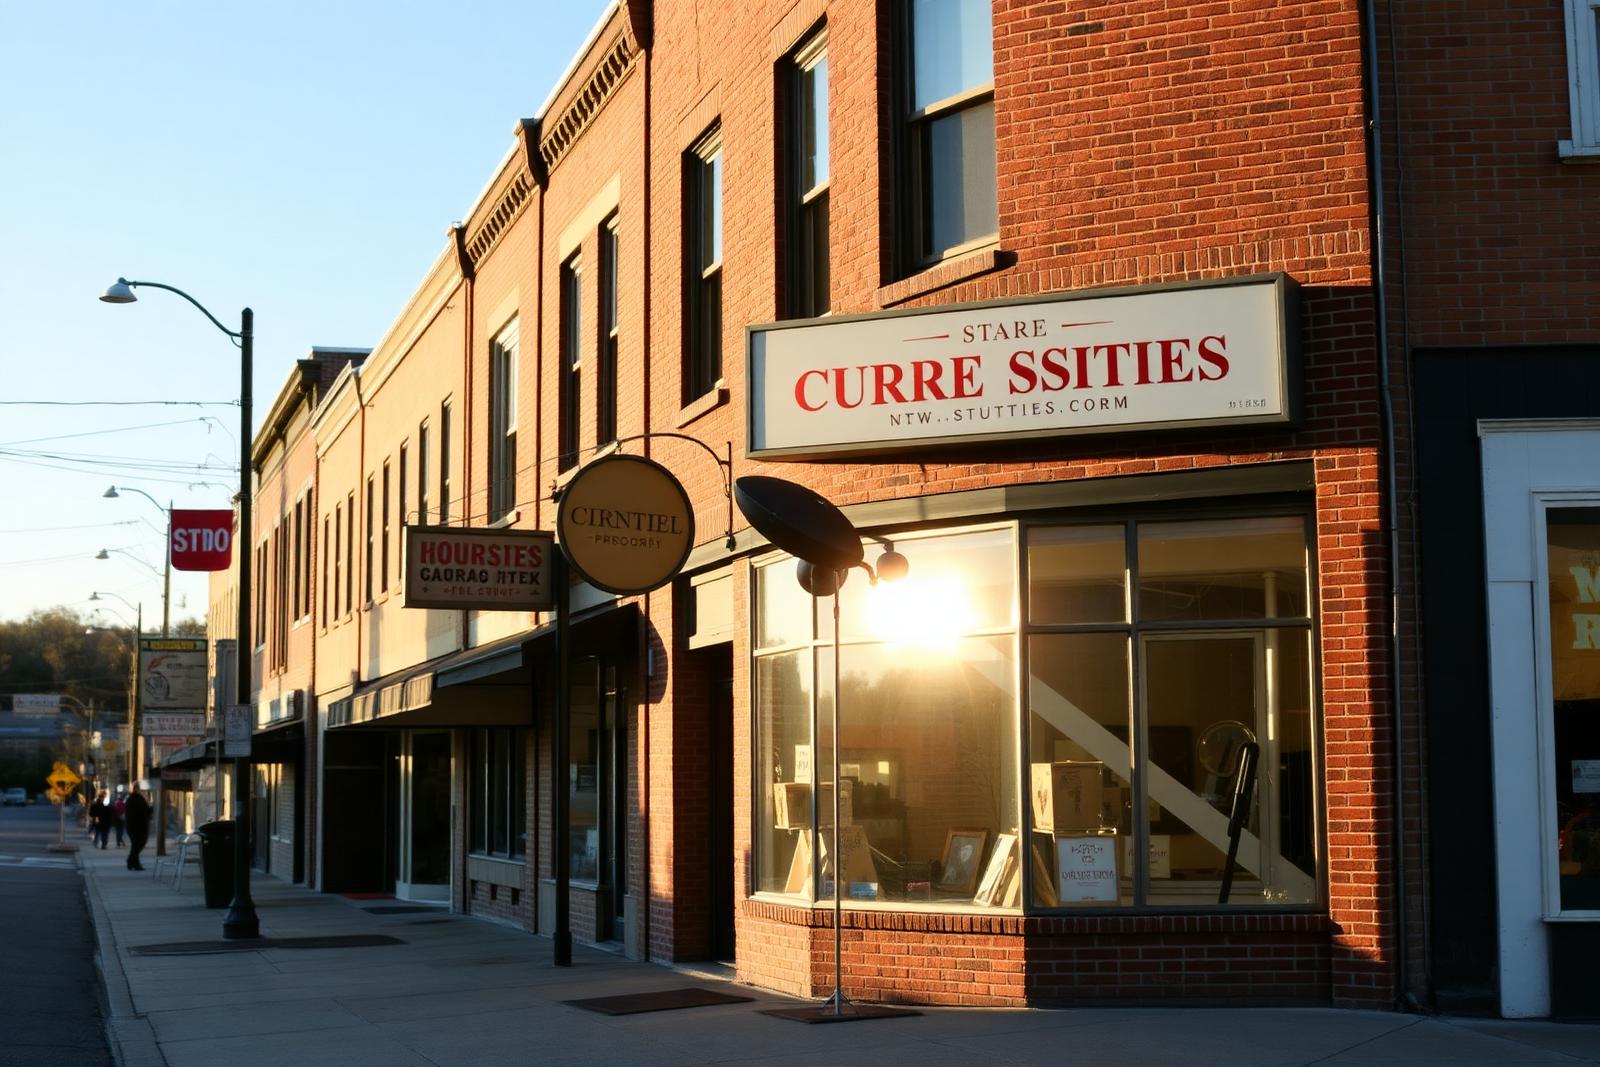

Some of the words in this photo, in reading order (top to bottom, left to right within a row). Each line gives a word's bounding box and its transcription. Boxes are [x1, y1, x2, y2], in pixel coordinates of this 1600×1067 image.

[963, 319, 1047, 343] STARE
[794, 355, 984, 412] CURRE
[1008, 335, 1230, 395] SSITIES
[420, 541, 543, 568] HOURSIES
